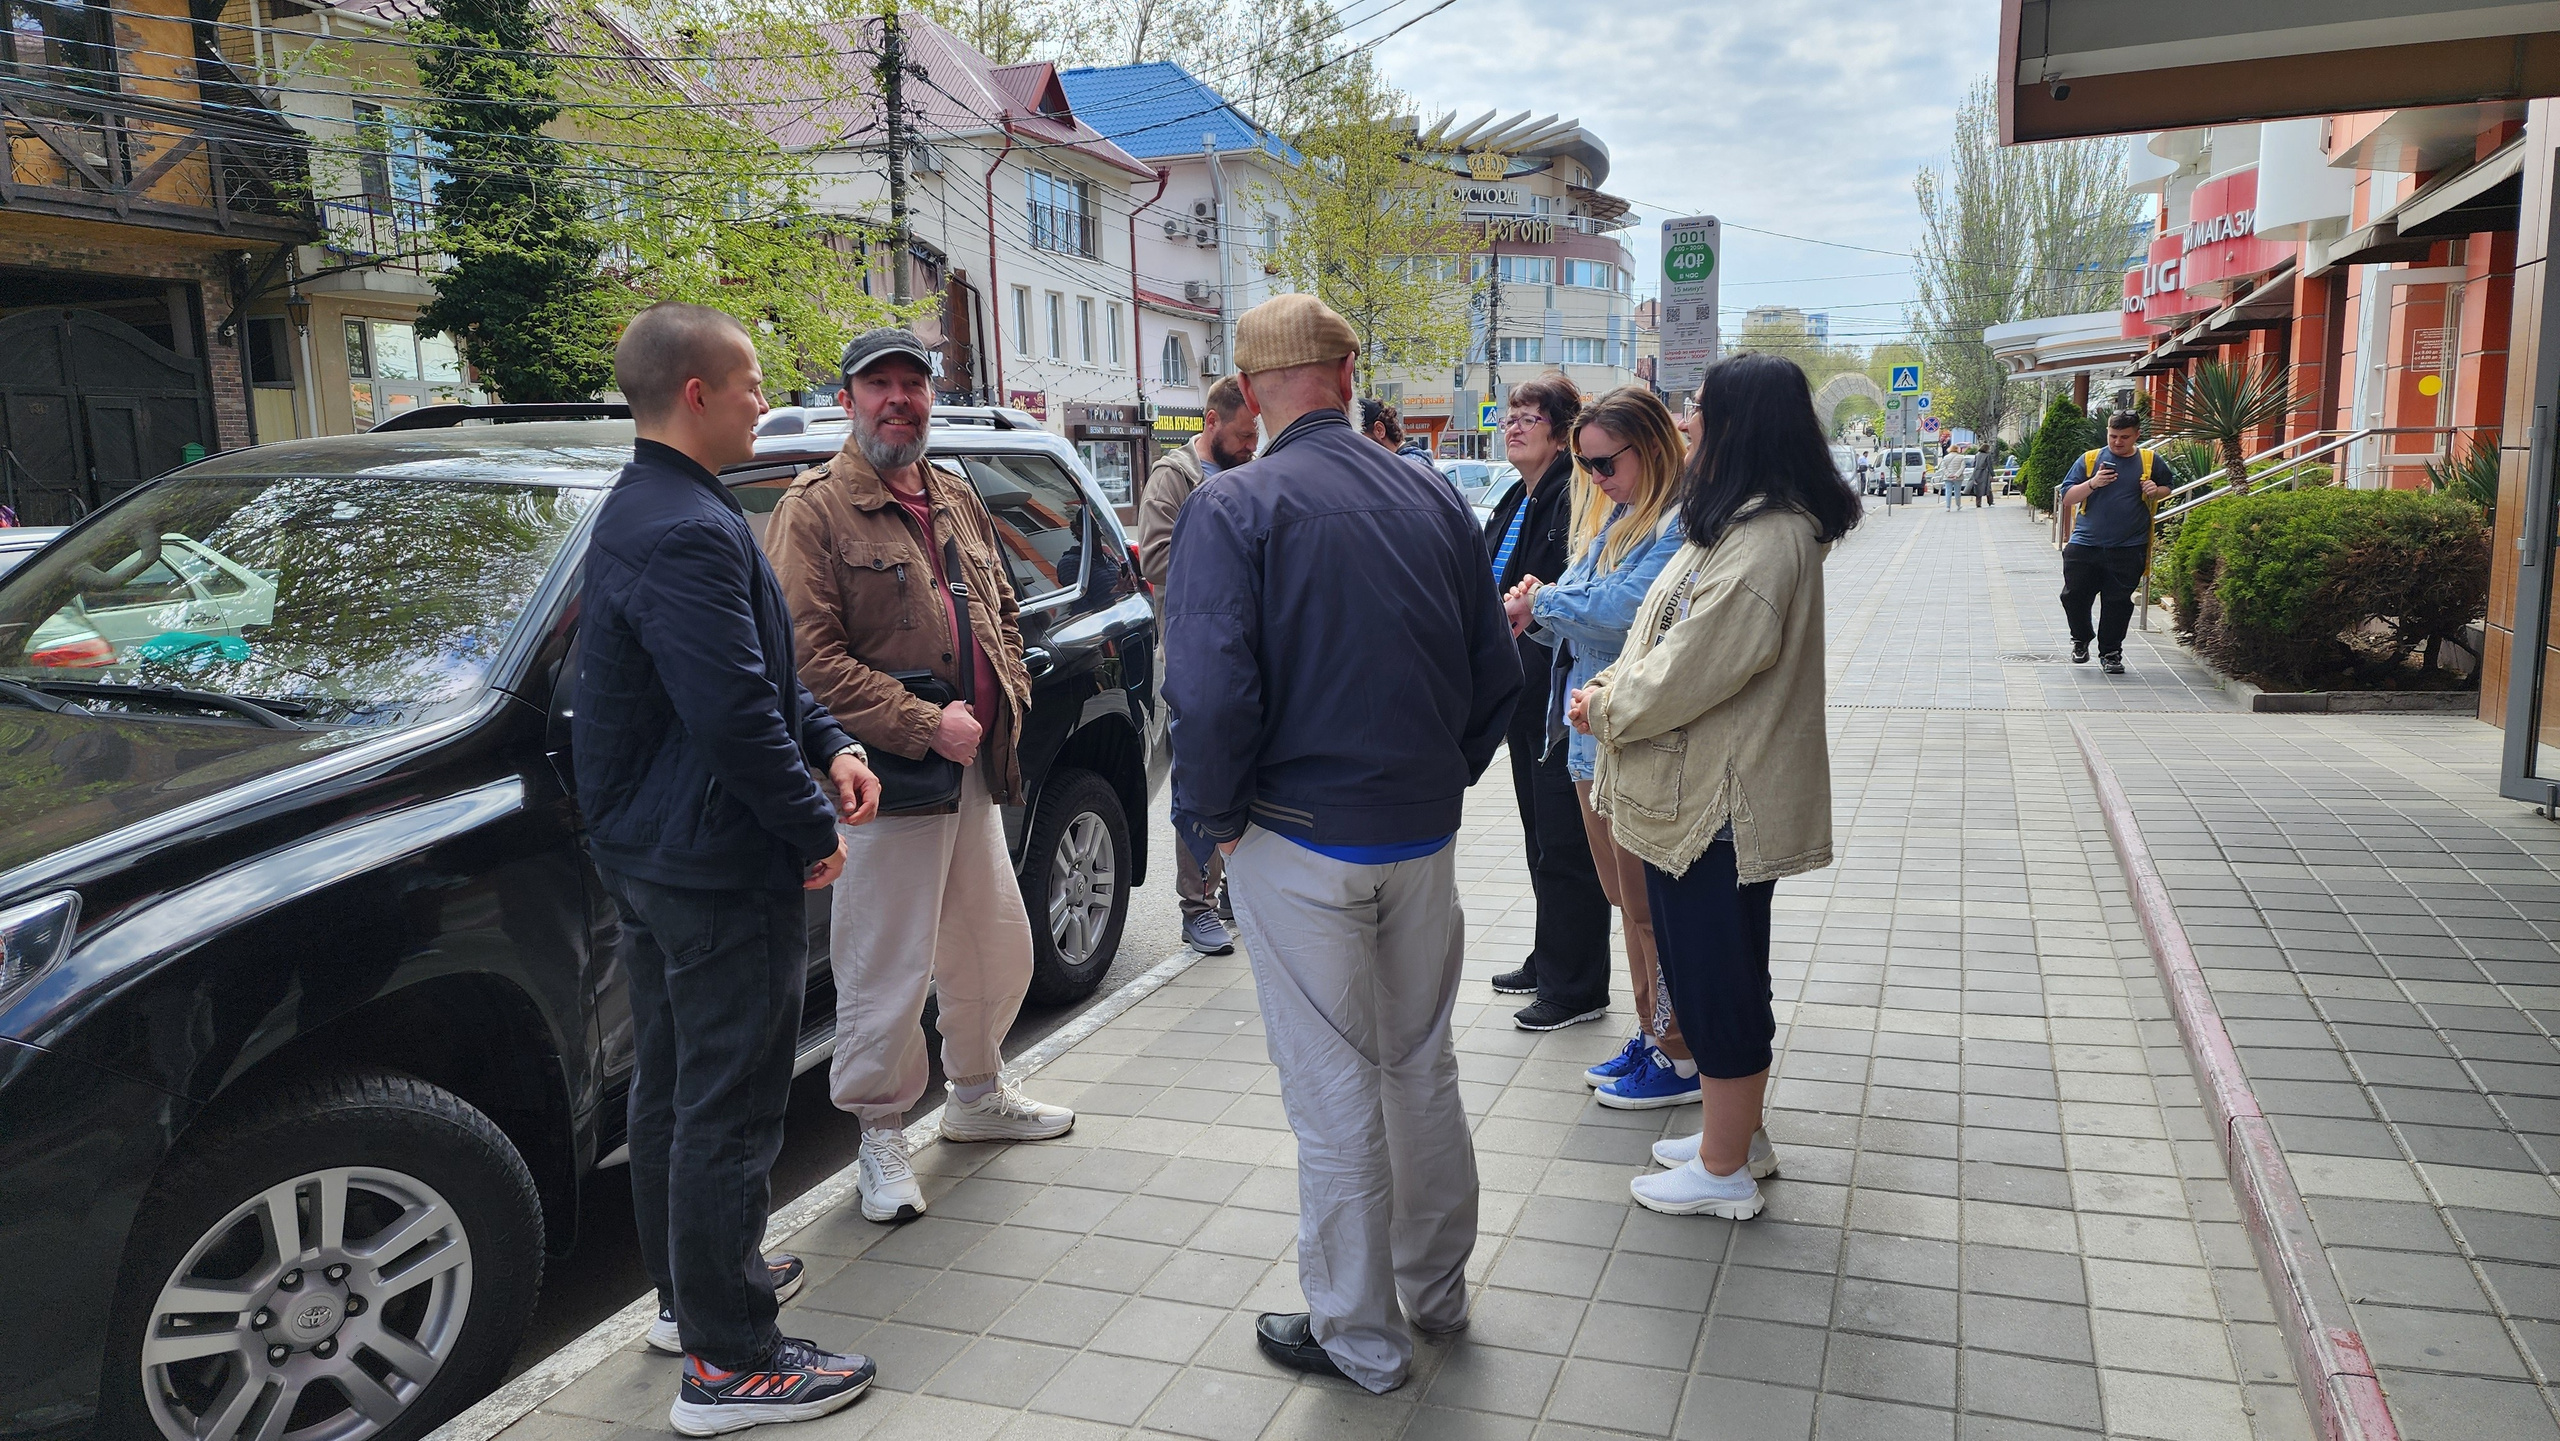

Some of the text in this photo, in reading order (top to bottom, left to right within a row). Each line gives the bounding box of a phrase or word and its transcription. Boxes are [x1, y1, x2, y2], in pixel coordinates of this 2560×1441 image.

[1451, 186, 1520, 205] РЕСТОРАН
[1672, 230, 1706, 245] 1001
[1683, 285, 1705, 293] минут
[1088, 408, 1124, 421] ТРИУМФ
[1174, 415, 1204, 432] КУБАНИ
